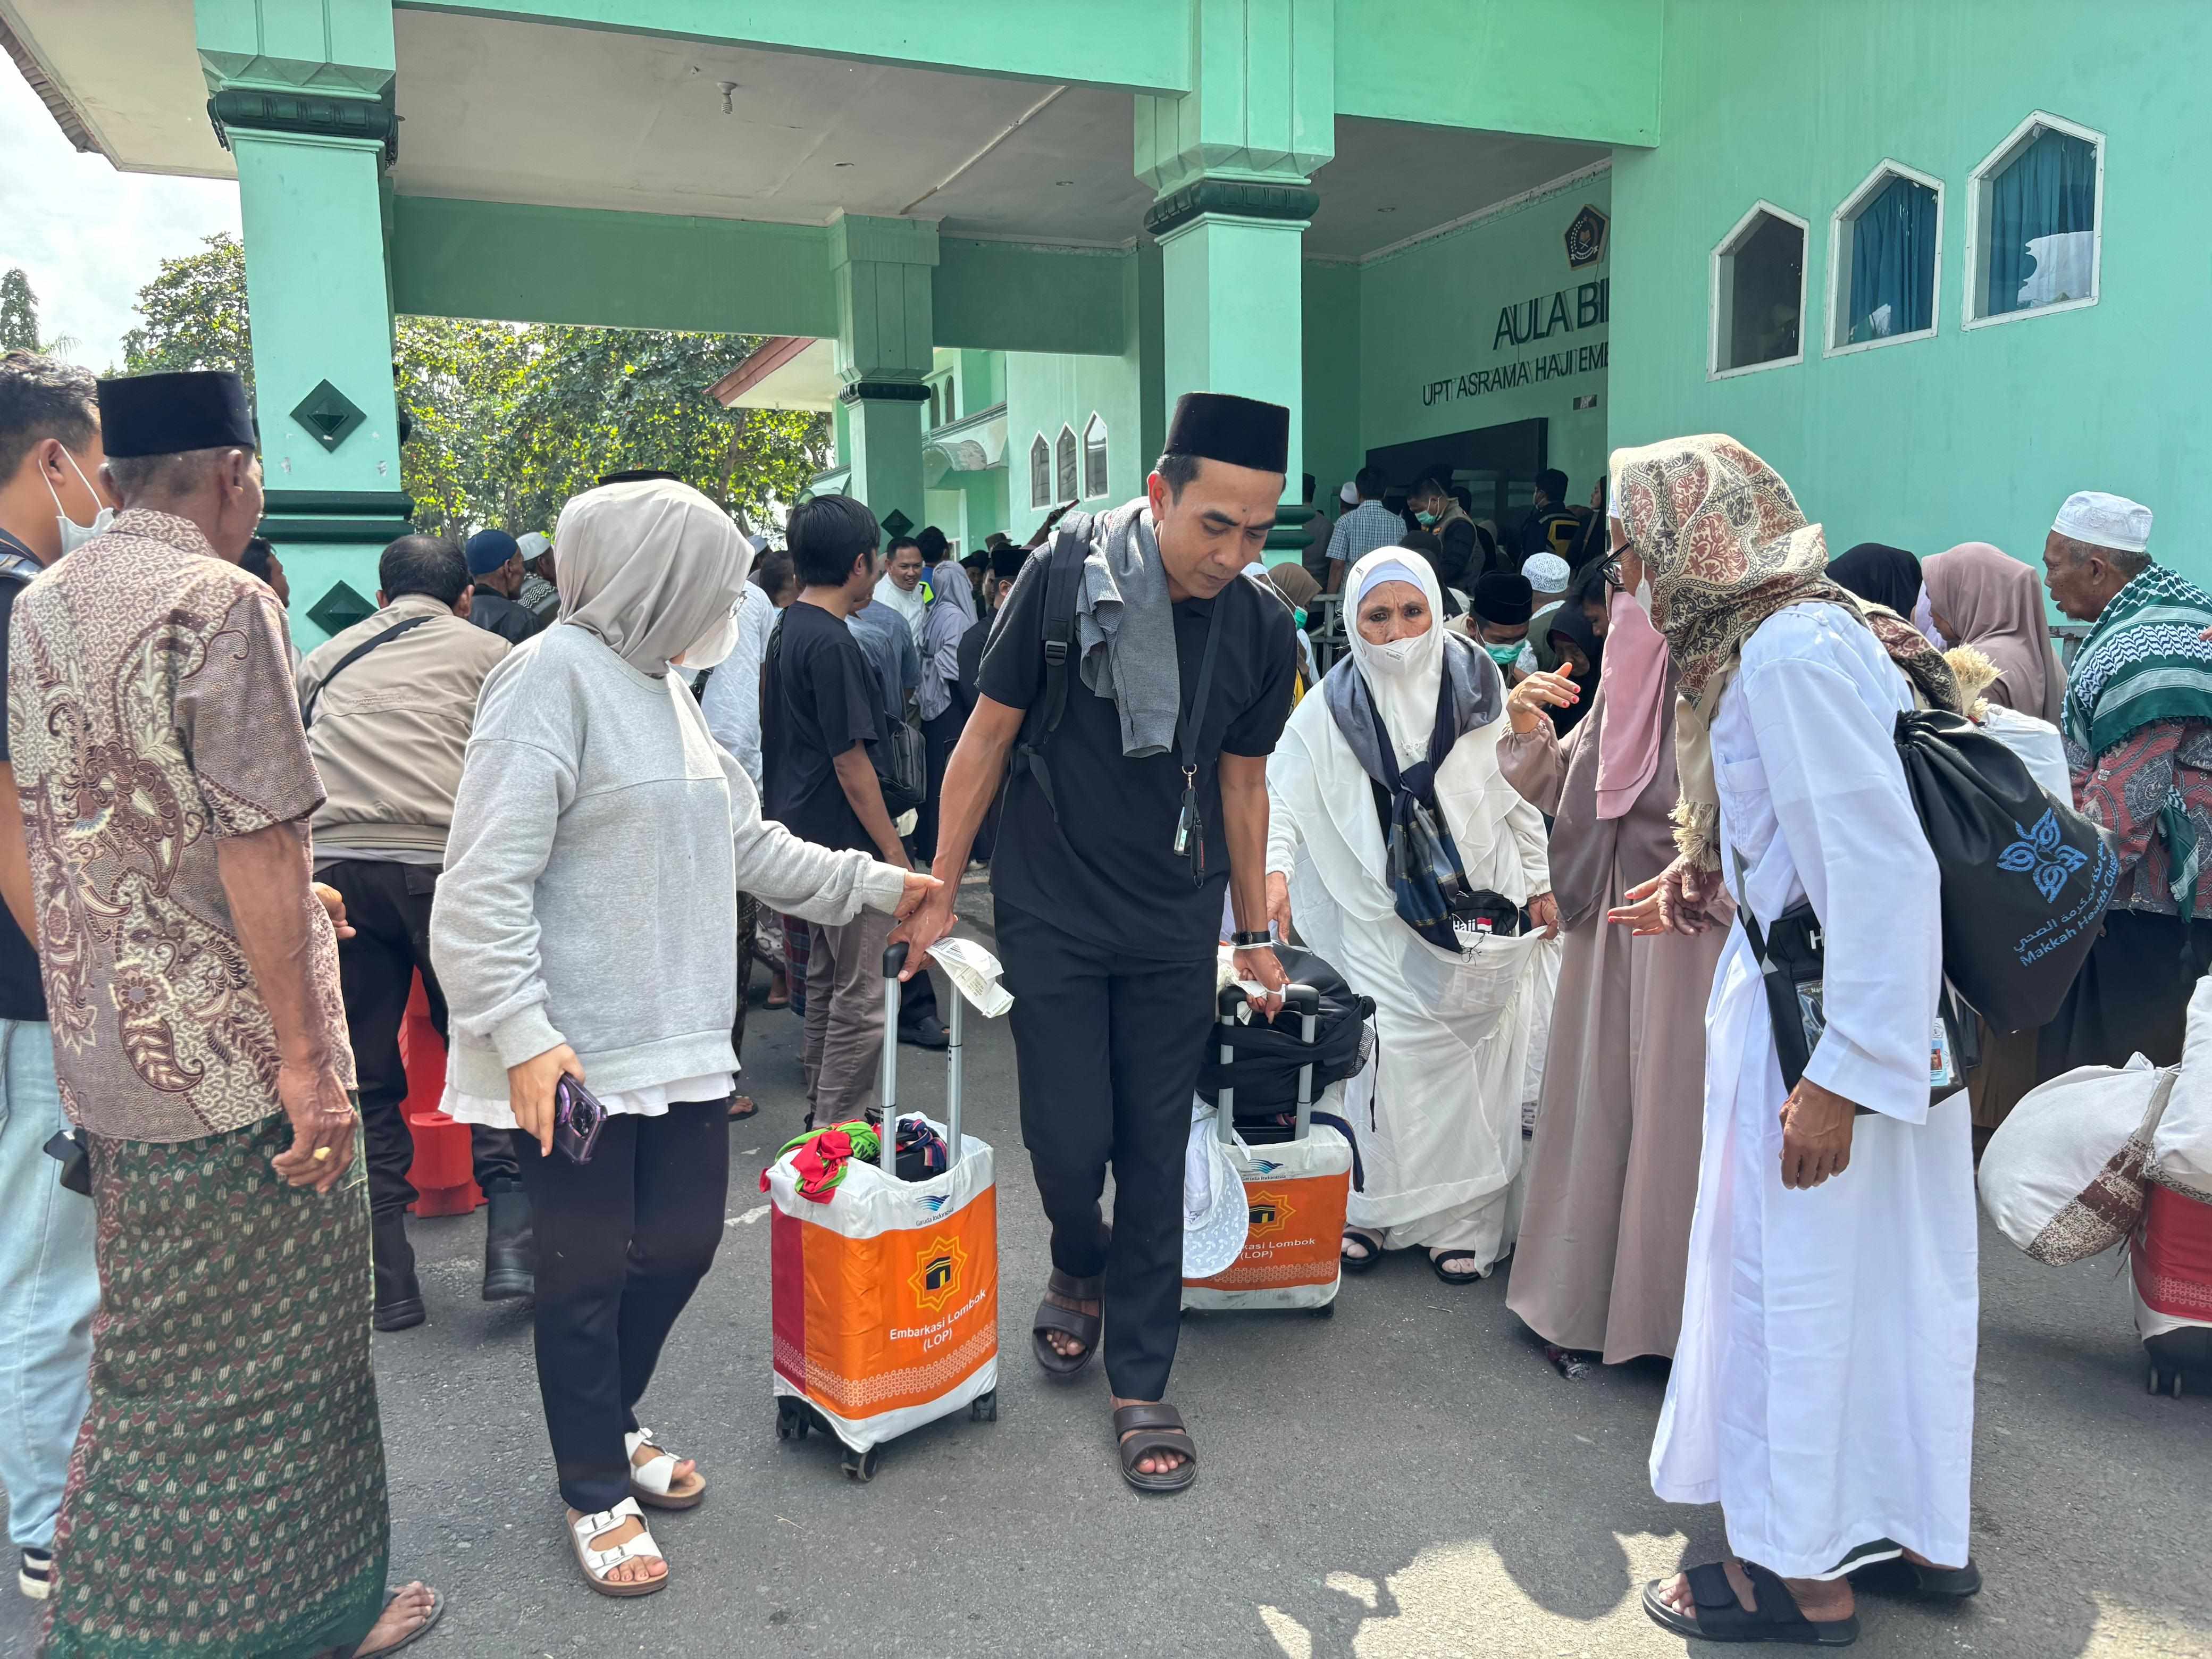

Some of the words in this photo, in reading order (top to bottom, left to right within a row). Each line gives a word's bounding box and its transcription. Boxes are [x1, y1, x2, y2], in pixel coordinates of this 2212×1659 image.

[1493, 291, 1570, 350] AULA
[1577, 277, 1610, 329] BI
[1423, 379, 1453, 406] UPT
[1456, 362, 1529, 399] ASRAMA
[1535, 350, 1572, 382] HAJI
[1809, 927, 1824, 949] H
[2020, 928, 2077, 967] Makkah
[2077, 889, 2108, 929] Health
[1241, 1250, 1273, 1260] (LOP)
[1269, 1238, 1316, 1249] Lombok
[890, 1317, 945, 1340] Embarkasi
[948, 1288, 986, 1324] Lombok
[923, 1328, 952, 1352] (LOP)
